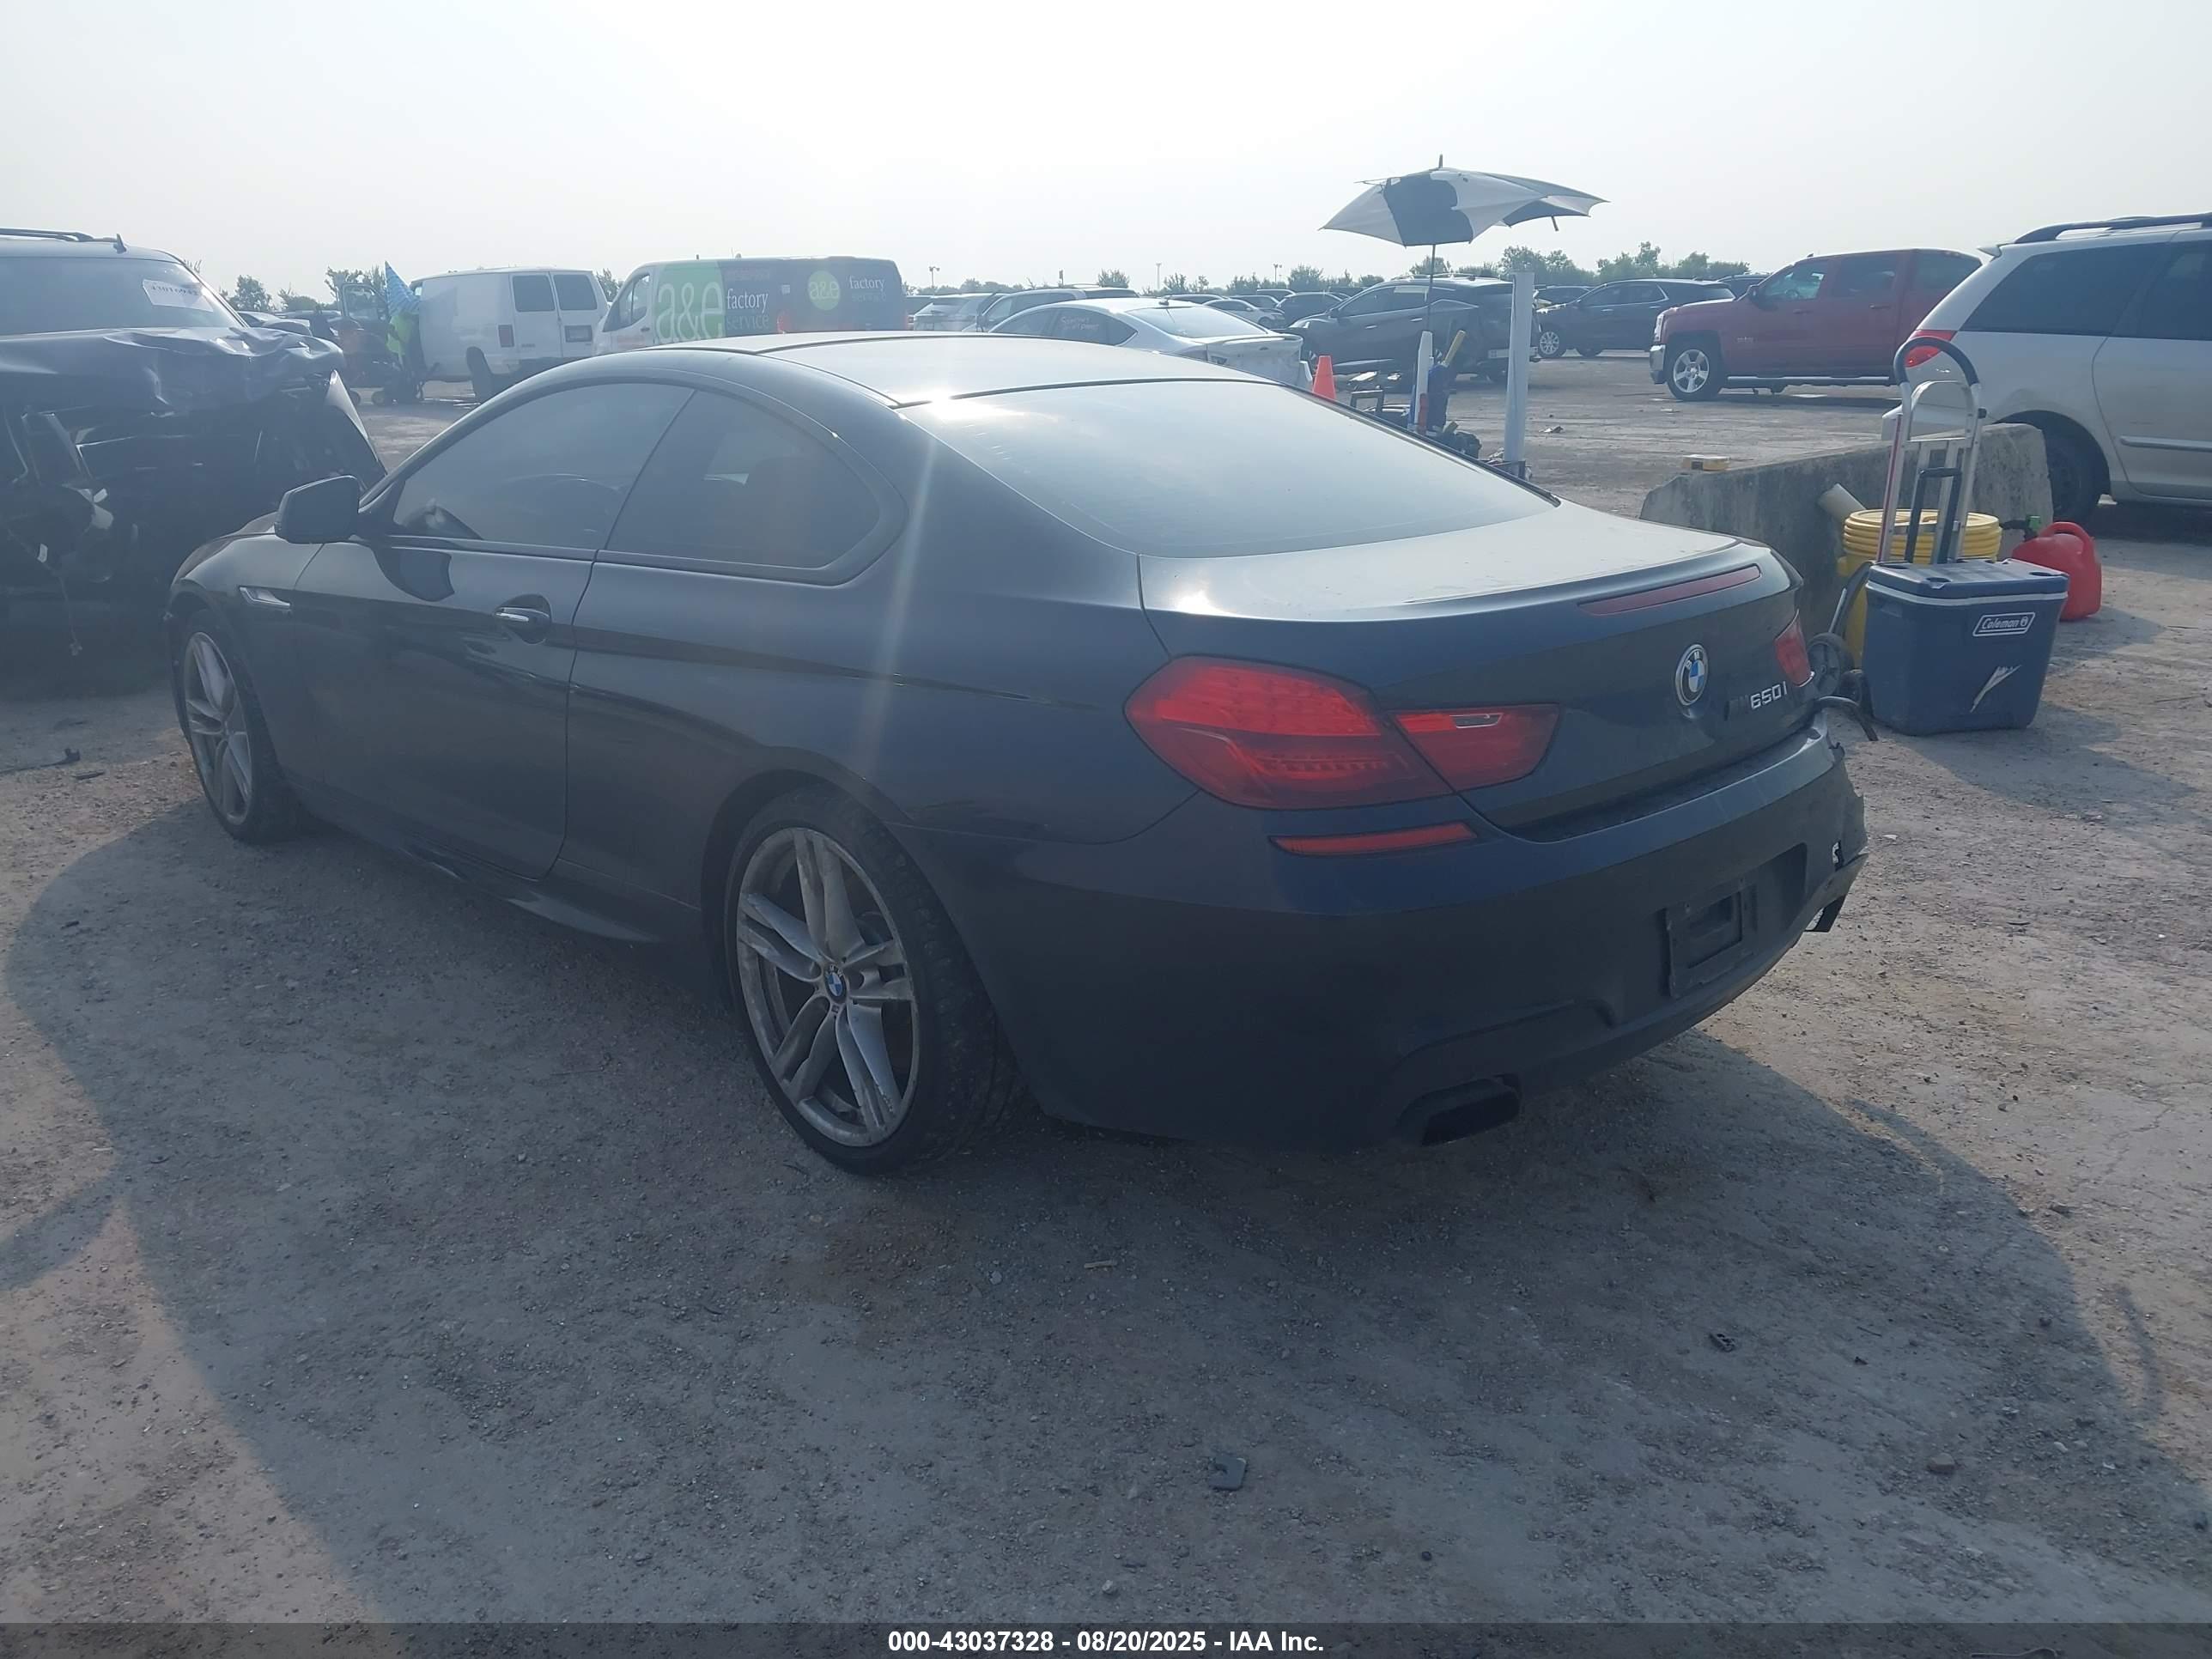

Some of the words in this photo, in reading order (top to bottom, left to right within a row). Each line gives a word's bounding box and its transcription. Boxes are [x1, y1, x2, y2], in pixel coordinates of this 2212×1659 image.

[810, 281, 840, 301] a&e
[849, 275, 885, 292] factory
[726, 288, 769, 313] factory
[655, 281, 725, 343] a&e
[726, 314, 769, 330] service
[1982, 617, 2020, 629] Coleman
